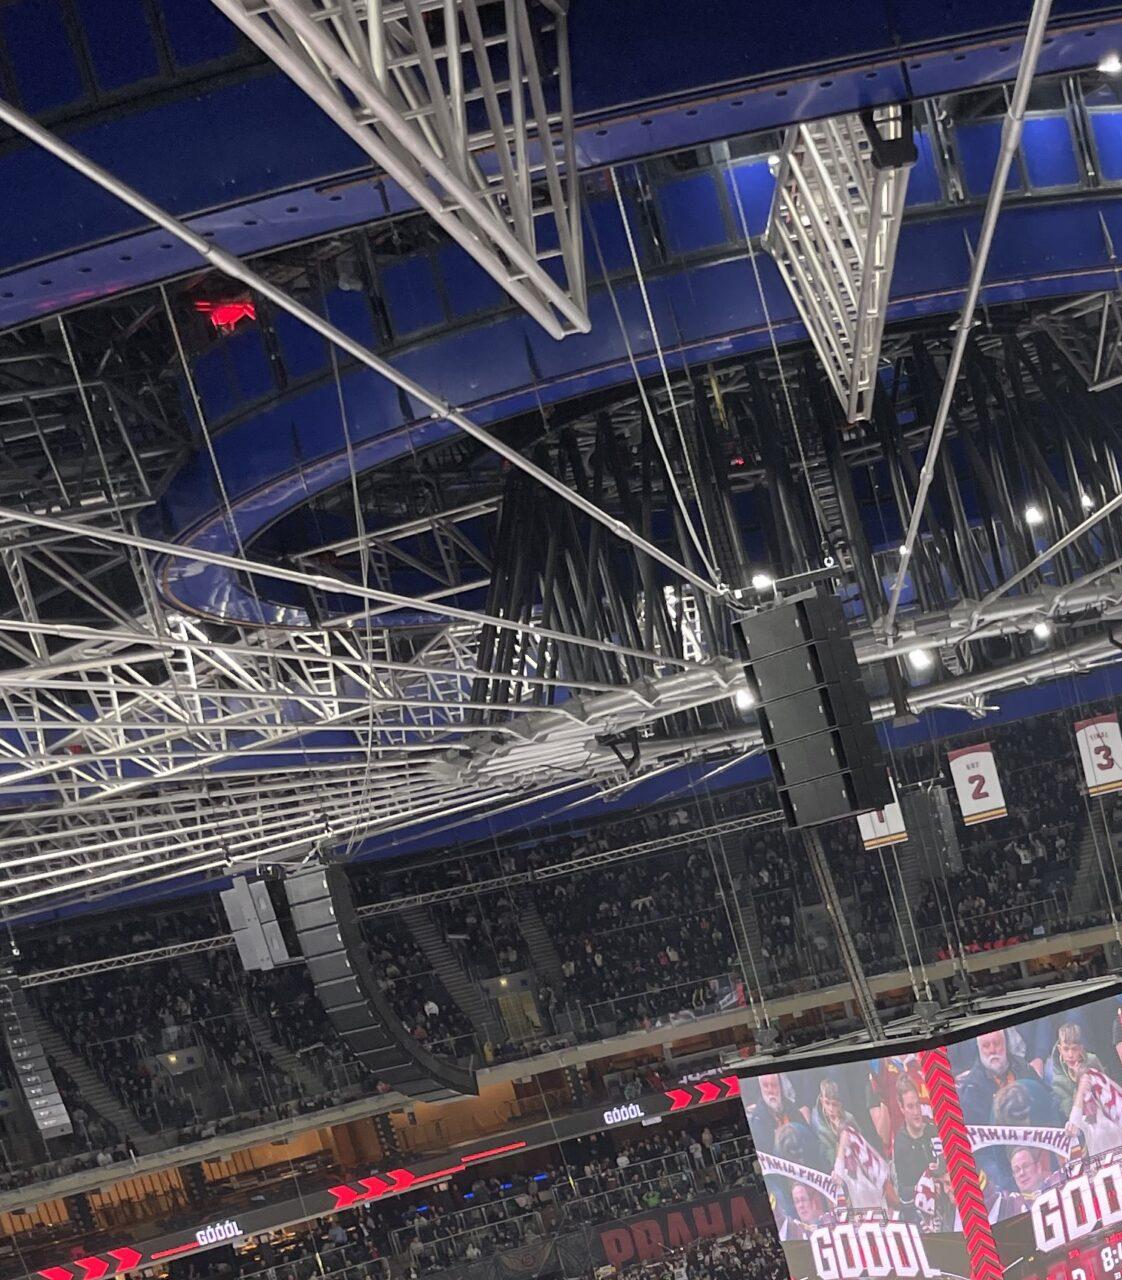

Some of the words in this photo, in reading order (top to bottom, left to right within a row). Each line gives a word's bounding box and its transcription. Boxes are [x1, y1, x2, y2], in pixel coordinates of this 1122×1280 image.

[1094, 745, 1115, 771] 3
[968, 774, 989, 800] 2
[603, 1103, 645, 1125] GÓÓÓL
[196, 1220, 243, 1246] GÓÓÓL
[601, 1195, 756, 1268] PRAHA
[810, 1210, 941, 1280] GÓÓÓL
